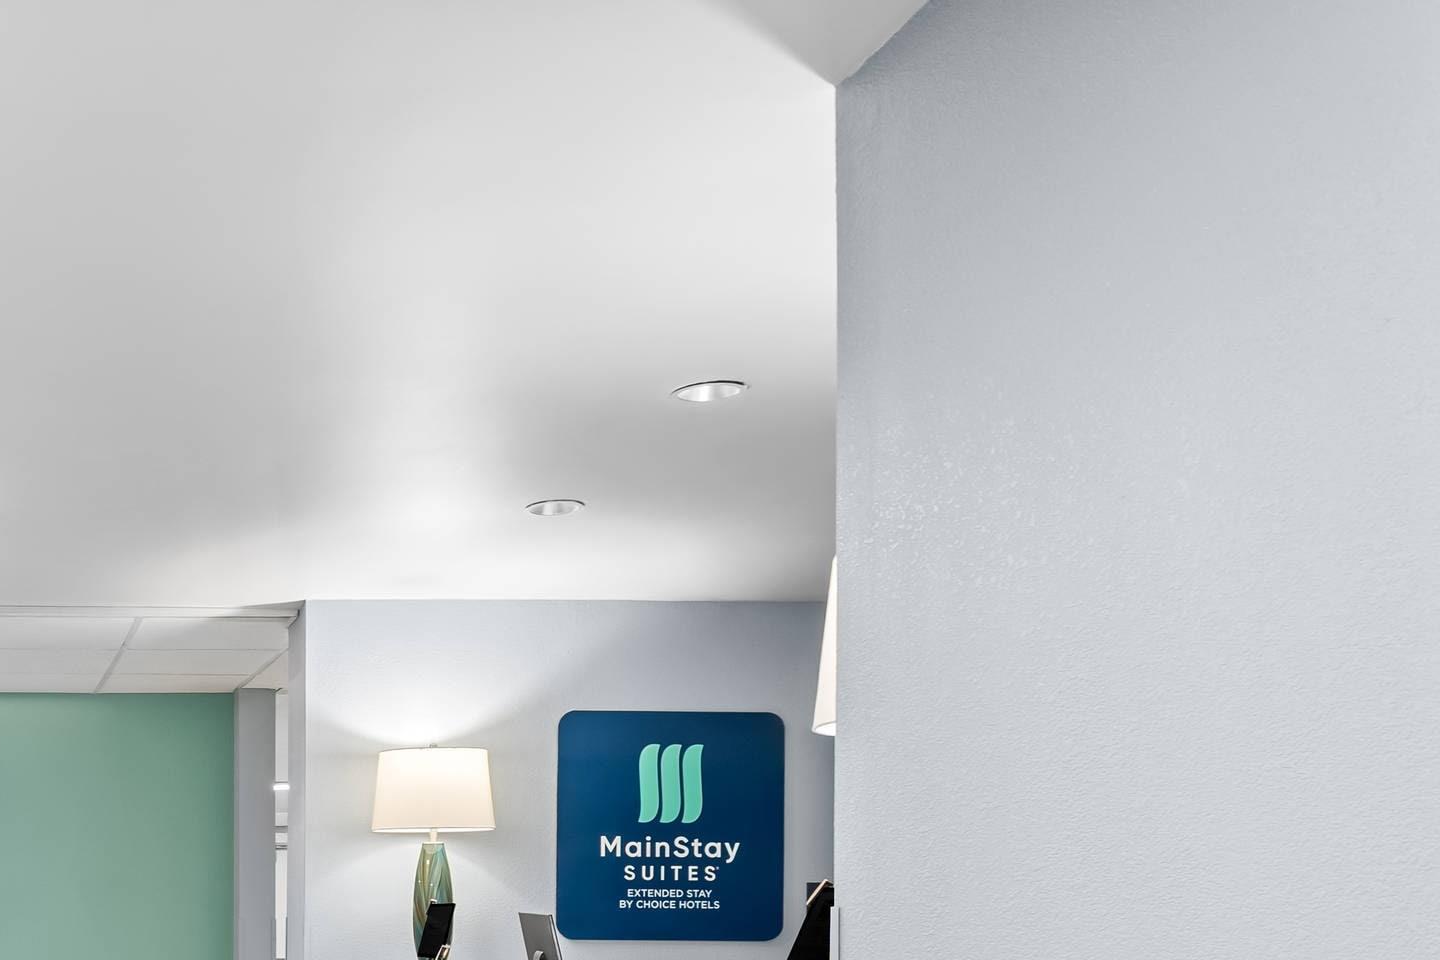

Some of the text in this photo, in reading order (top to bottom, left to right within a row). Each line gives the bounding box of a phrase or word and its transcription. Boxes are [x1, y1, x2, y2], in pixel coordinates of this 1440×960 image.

[600, 835, 740, 863] MainStay
[624, 865, 717, 881] SUITES
[627, 889, 712, 898] EXTENDED STAY
[619, 900, 720, 910] BY CHOICE HOTELS
